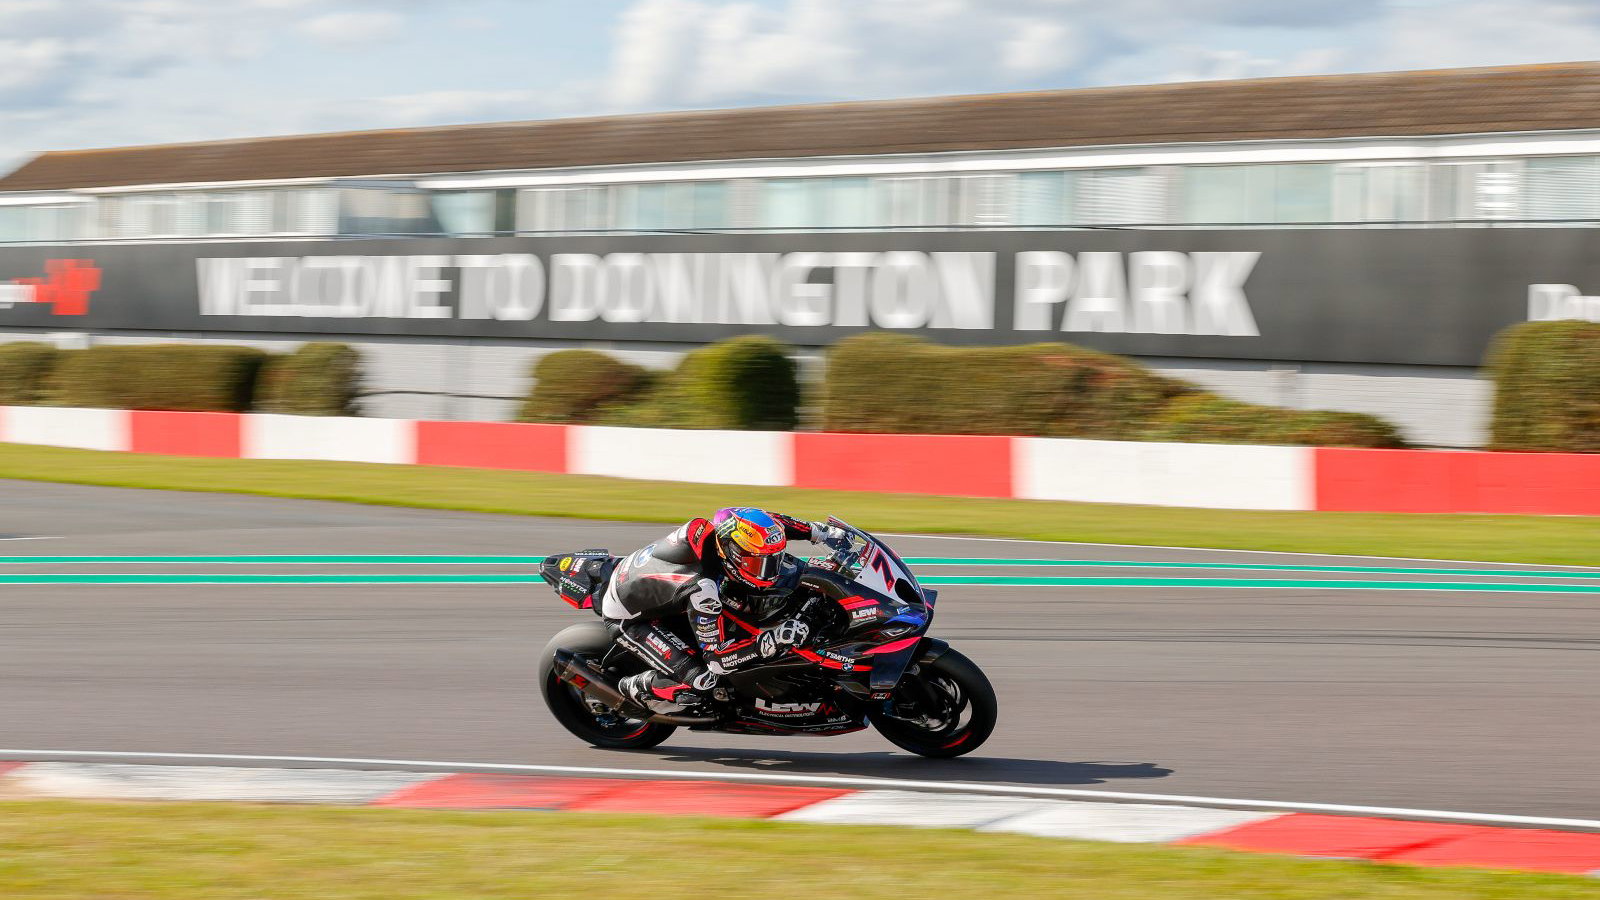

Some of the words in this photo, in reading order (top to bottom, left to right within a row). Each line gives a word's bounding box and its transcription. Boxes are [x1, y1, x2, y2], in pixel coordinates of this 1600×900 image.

[195, 255, 452, 319] WELCOME
[453, 253, 546, 321] TO
[548, 250, 997, 330] DONINGTON
[1013, 250, 1263, 336] PARK
[870, 547, 896, 594] 7
[851, 607, 877, 618] LEW
[646, 632, 672, 653] LEW
[721, 653, 738, 663] BMW
[755, 697, 822, 712] LEW
